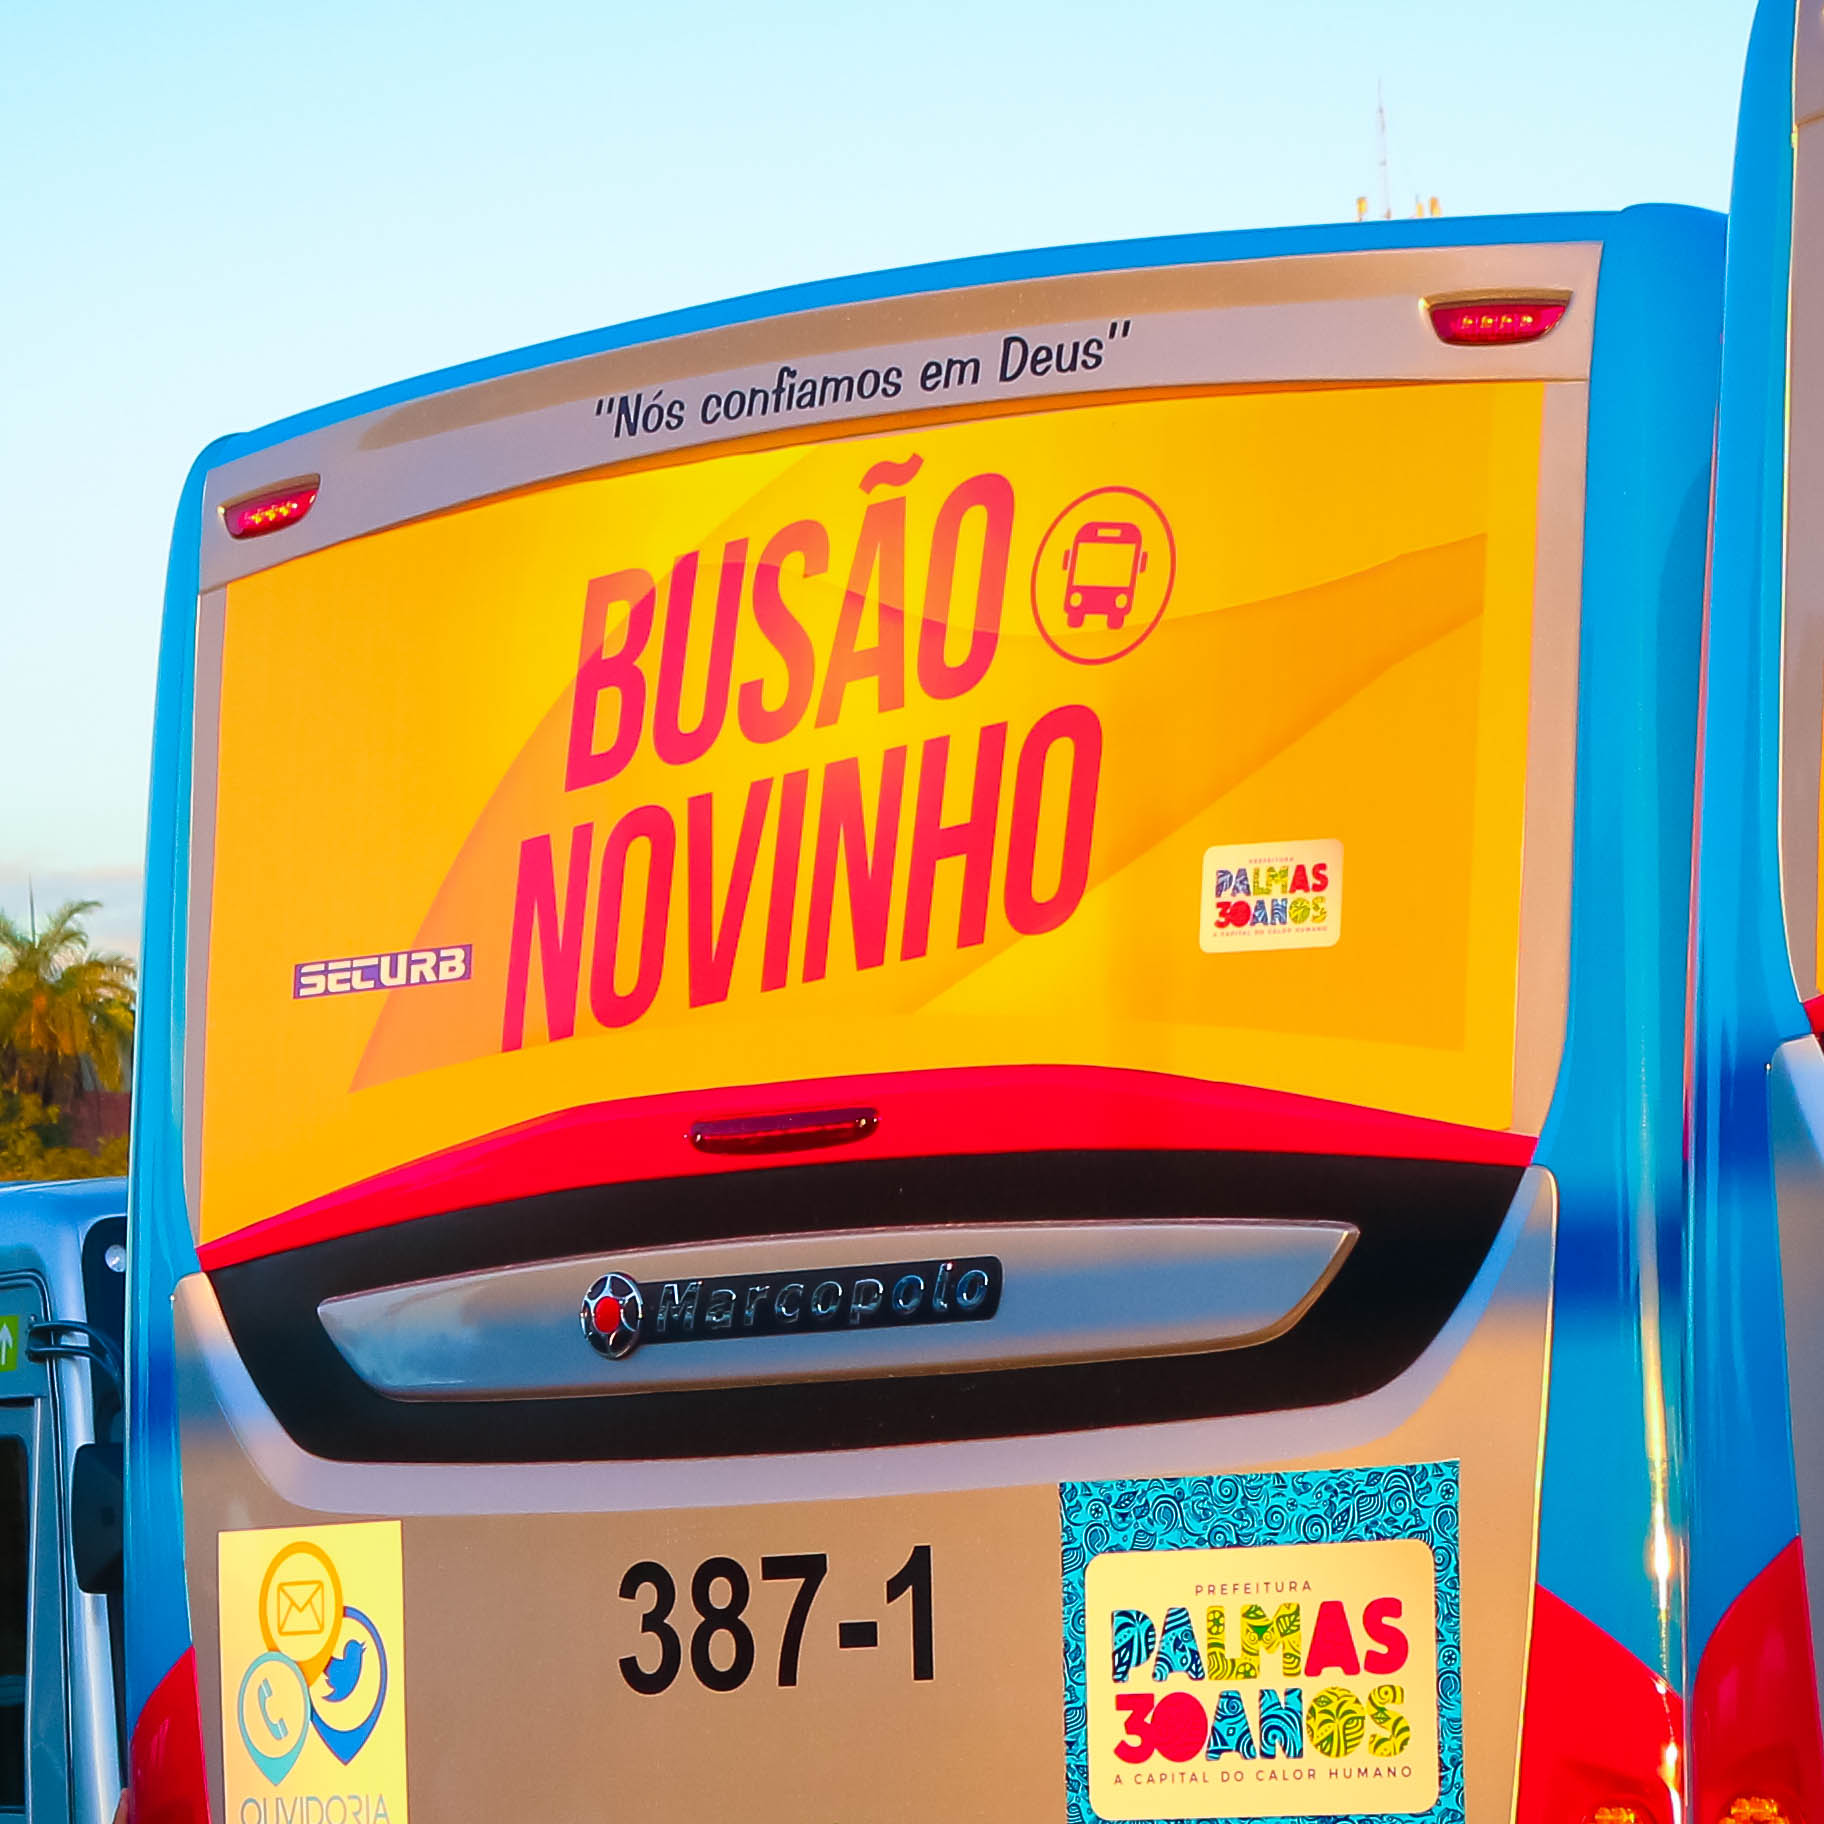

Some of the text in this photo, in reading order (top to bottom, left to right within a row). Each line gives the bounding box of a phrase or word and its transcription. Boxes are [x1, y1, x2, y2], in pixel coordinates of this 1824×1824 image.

[701, 366, 902, 425] confiamos
[919, 355, 980, 392] em
[999, 320, 1132, 383] Deus"
[564, 452, 1015, 793] BUSÃO
[501, 704, 1103, 1053] NOVINHO
[1215, 862, 1329, 898] PALMAS
[299, 947, 466, 997] SECURB
[655, 1261, 990, 1334] Marcopolo
[618, 1544, 934, 1695] 387-1
[1194, 1580, 1313, 1596] PREFEITURA
[1111, 1597, 1410, 1683] PALMAS
[1113, 1765, 1413, 1785] A CAPITAL DO CALOR HUMANO
